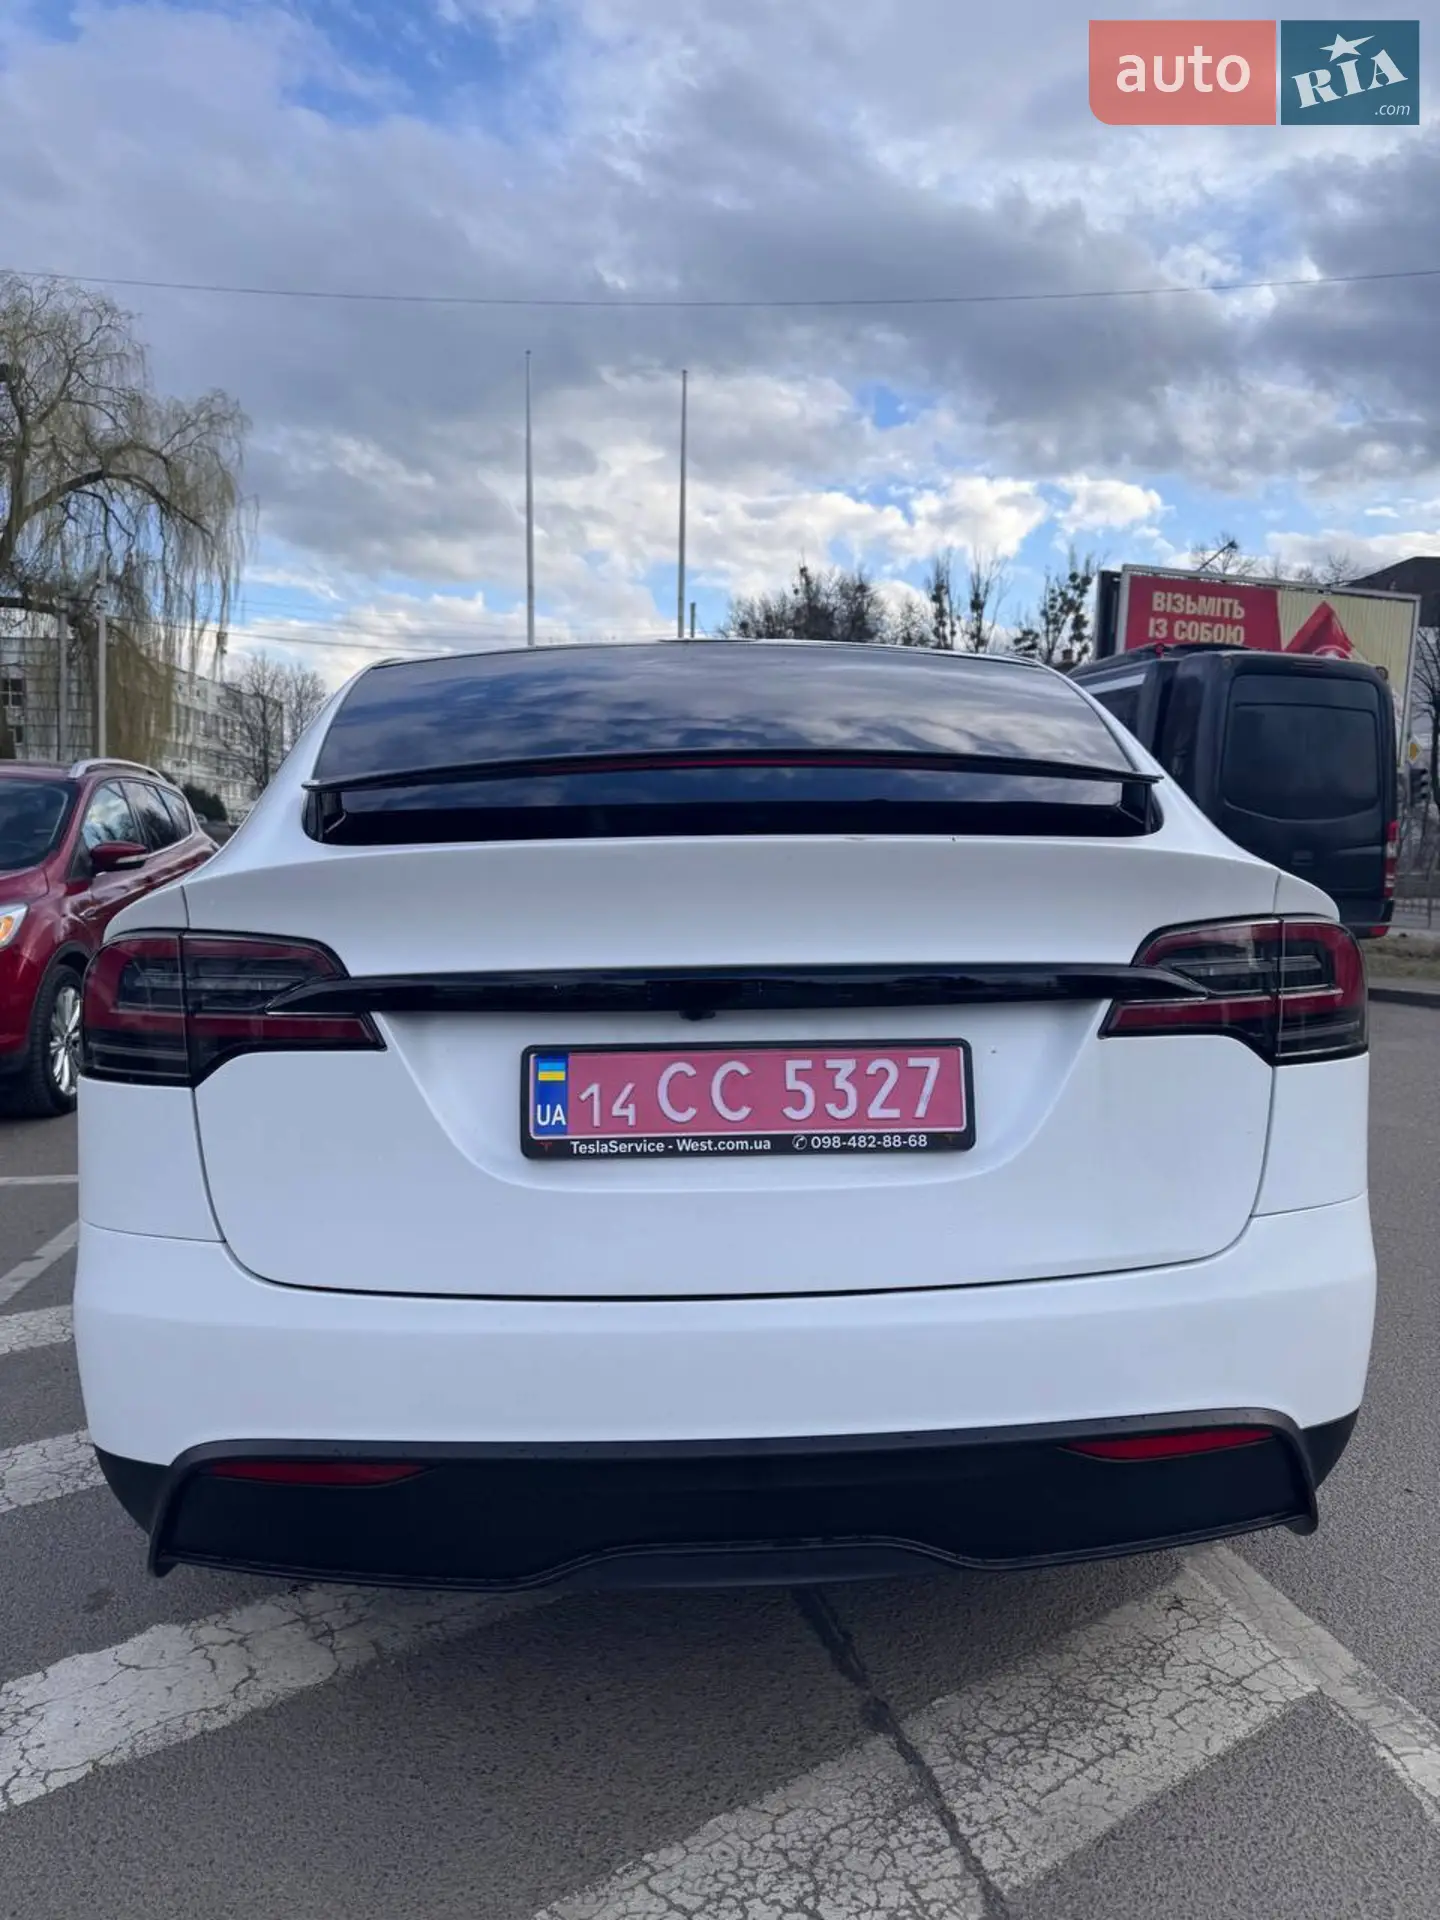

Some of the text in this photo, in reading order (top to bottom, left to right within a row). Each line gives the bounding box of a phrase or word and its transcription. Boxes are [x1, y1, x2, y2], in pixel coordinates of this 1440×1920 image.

[1152, 591, 1245, 619] ВІЗЬМІТЬ
[1149, 618, 1245, 643] ІЗ СОБОЮ
[536, 1057, 941, 1127] UA 14 CC 5327
[570, 1139, 665, 1155] TeslaService
[677, 1138, 771, 1153] West.com.ua
[811, 1134, 928, 1149] 098-482-88-68
